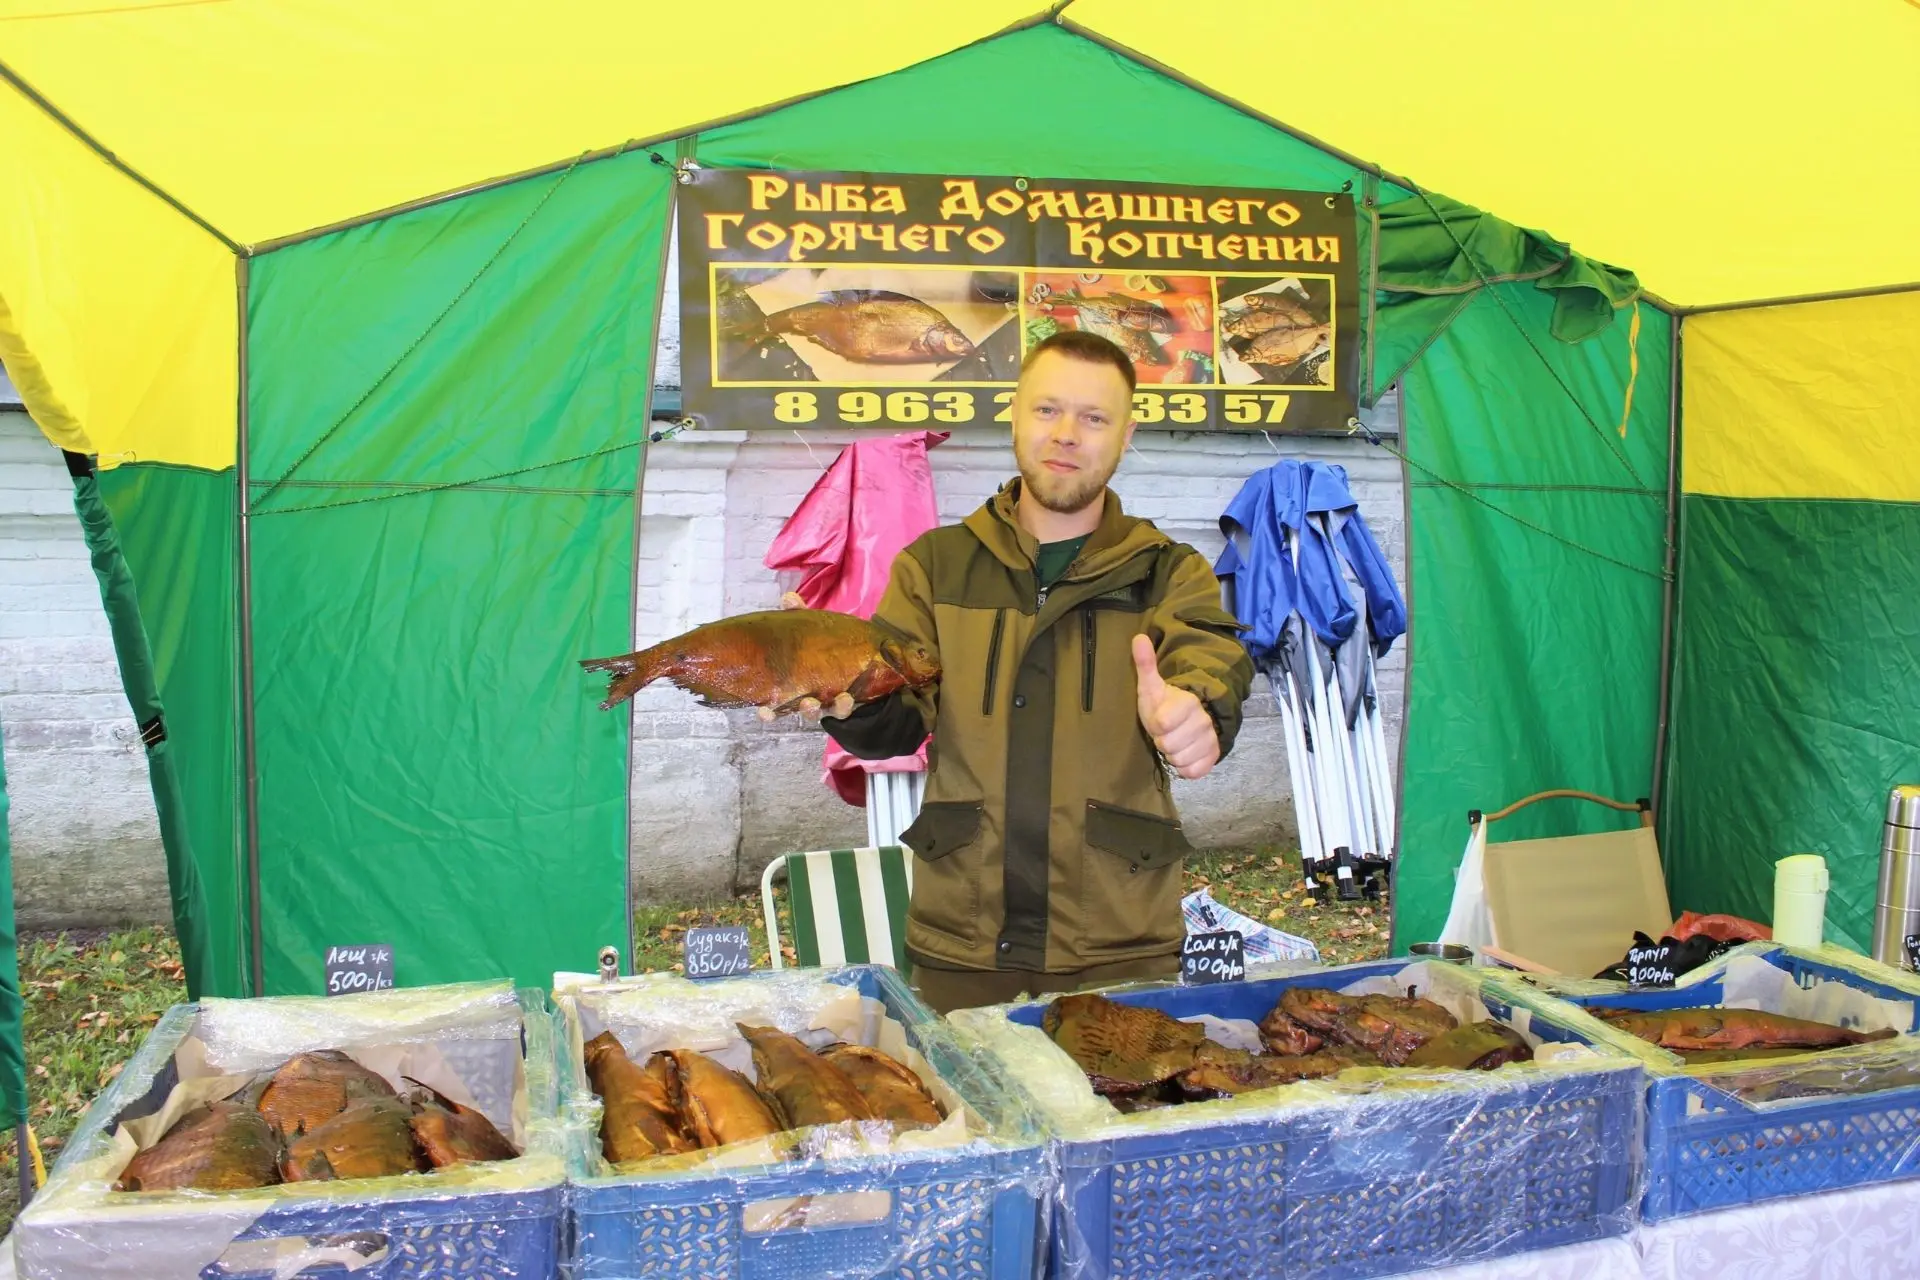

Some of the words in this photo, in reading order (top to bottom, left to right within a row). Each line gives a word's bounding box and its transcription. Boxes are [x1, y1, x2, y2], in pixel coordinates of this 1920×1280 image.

[774, 391, 818, 423] 8
[838, 391, 975, 423] 963
[1131, 392, 1207, 423] 33
[1224, 394, 1290, 424] 57
[686, 929, 731, 953] Судак
[1184, 935, 1216, 954] Сом
